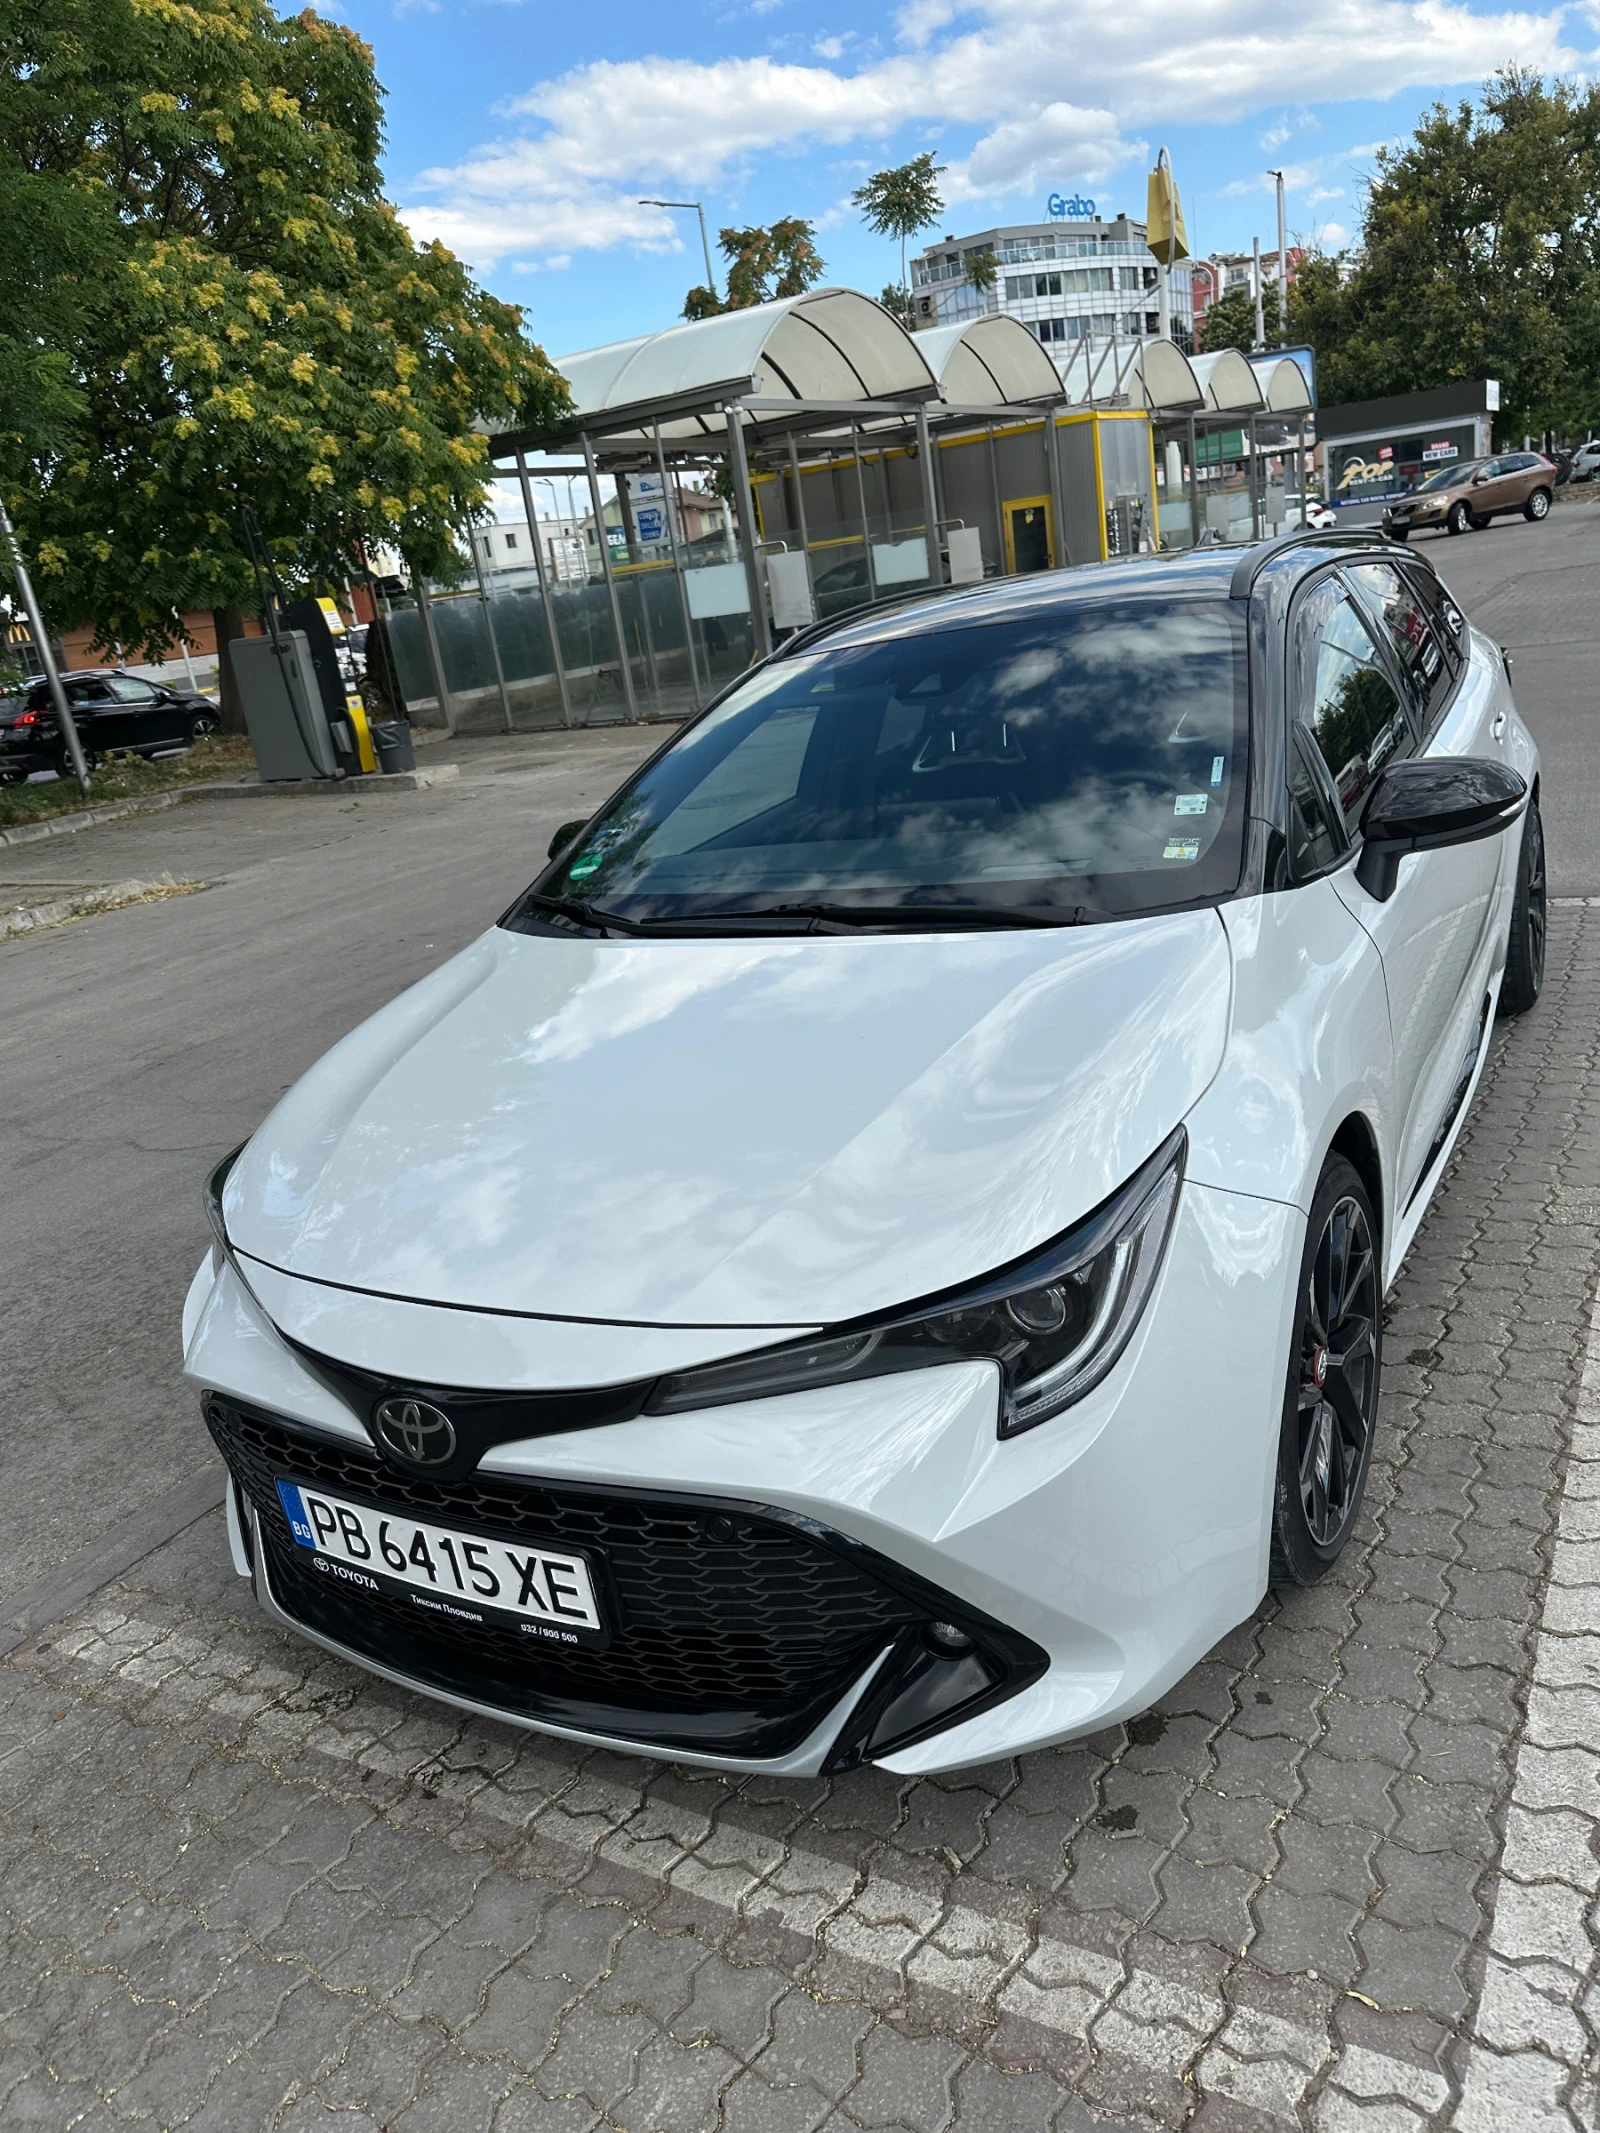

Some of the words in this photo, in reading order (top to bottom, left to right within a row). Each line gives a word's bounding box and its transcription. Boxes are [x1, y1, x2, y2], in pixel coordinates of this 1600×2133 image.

[1048, 193, 1096, 216] Grabo
[1425, 451, 1438, 460] NEW
[1440, 449, 1455, 458] CARS
[1337, 460, 1394, 490] TOP
[1349, 474, 1393, 486] RENT-A-CAR
[292, 1521, 311, 1539] BG
[307, 1496, 372, 1560] PB
[379, 1518, 501, 1597] 6415
[505, 1550, 588, 1620] XE
[331, 1564, 380, 1590] TOYOTA
[410, 1594, 442, 1611] Тиксим
[443, 1604, 483, 1622] Пловдив
